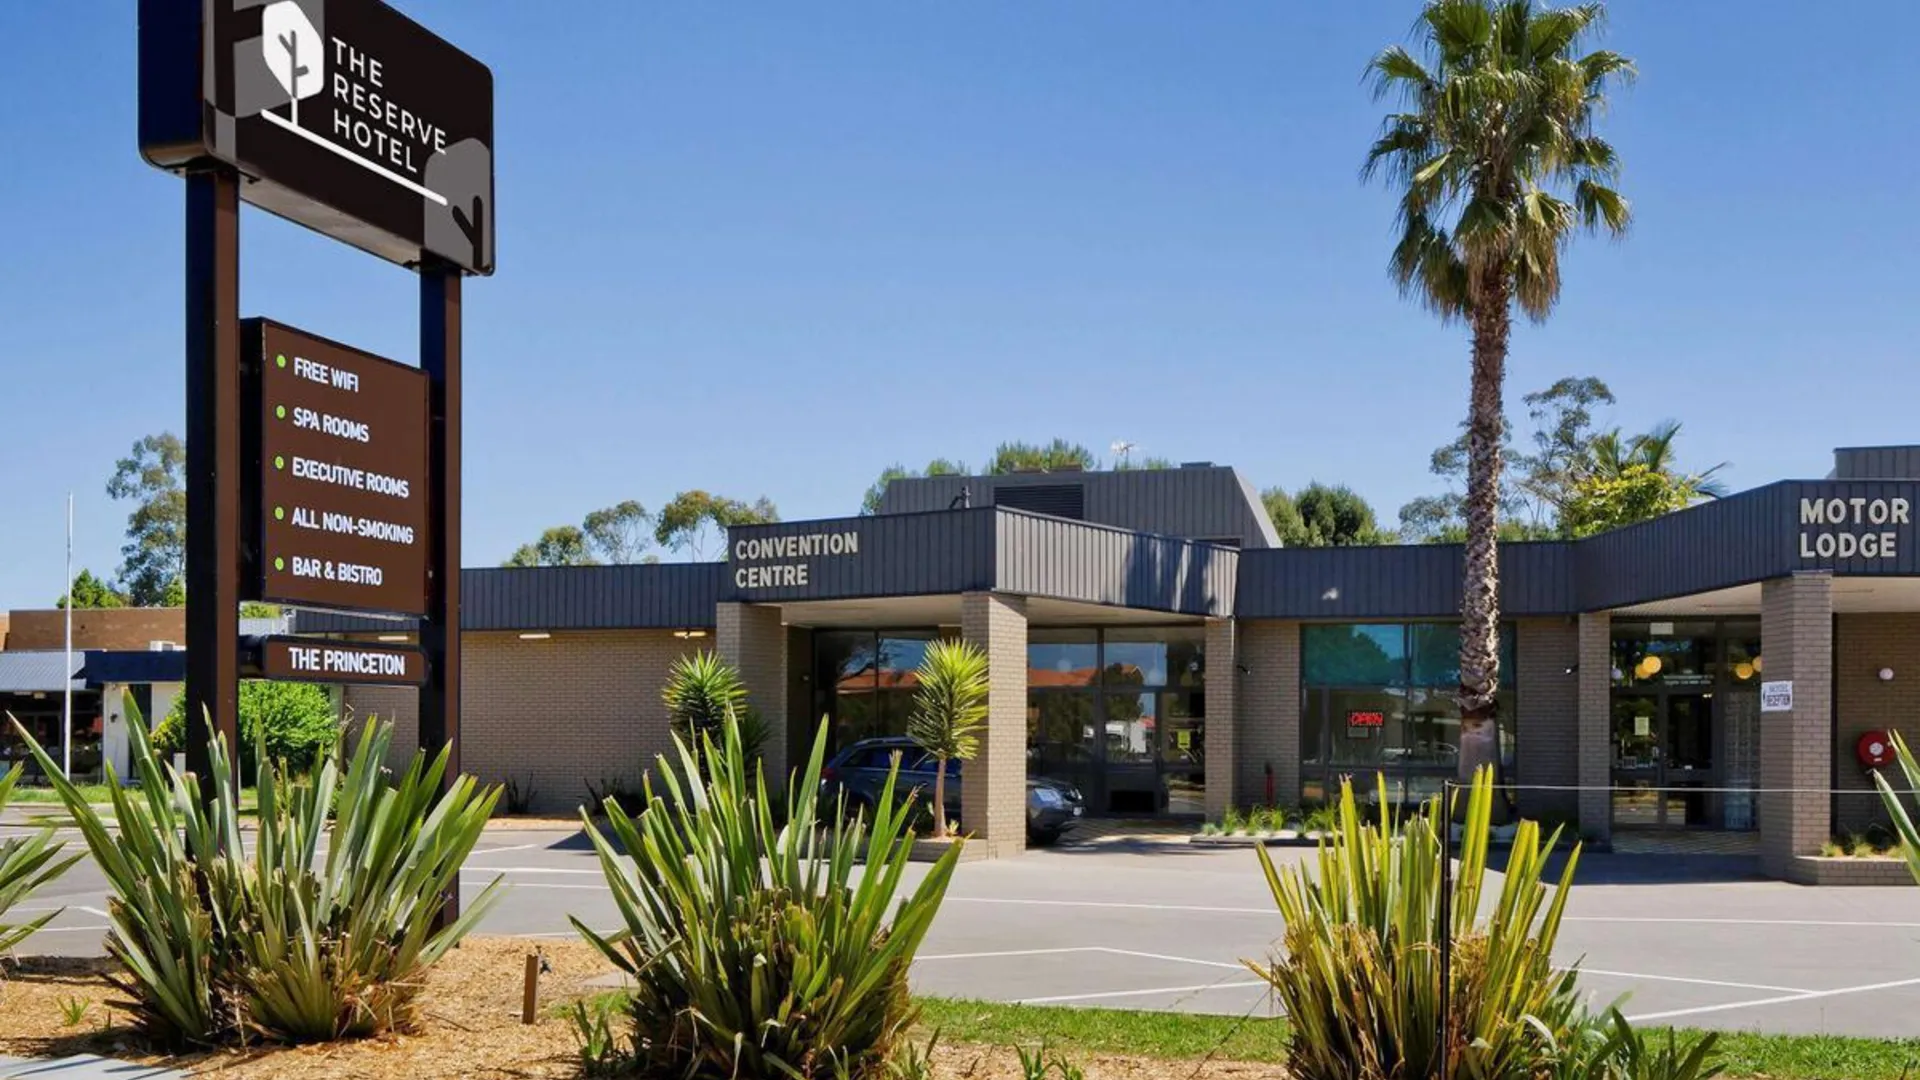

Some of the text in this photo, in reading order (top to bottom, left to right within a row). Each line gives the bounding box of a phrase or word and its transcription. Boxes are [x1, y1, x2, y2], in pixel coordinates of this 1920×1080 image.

[331, 36, 383, 88] THE
[333, 73, 447, 156] RESERVE
[333, 108, 417, 173] HOTEL
[293, 356, 360, 393] FREE WIFI
[293, 406, 370, 443] SPA ROOMS
[292, 456, 410, 498] EXECUTIVE ROOMS
[291, 507, 414, 544] ALL NON-SMOKING
[1800, 498, 1909, 525] MOTOR
[735, 532, 858, 560] CONVENTION
[1800, 533, 1897, 559] LODGE
[292, 556, 383, 586] BAR & BISTRO
[735, 564, 808, 588] CENTRE
[288, 647, 405, 676] THE PRINCETON
